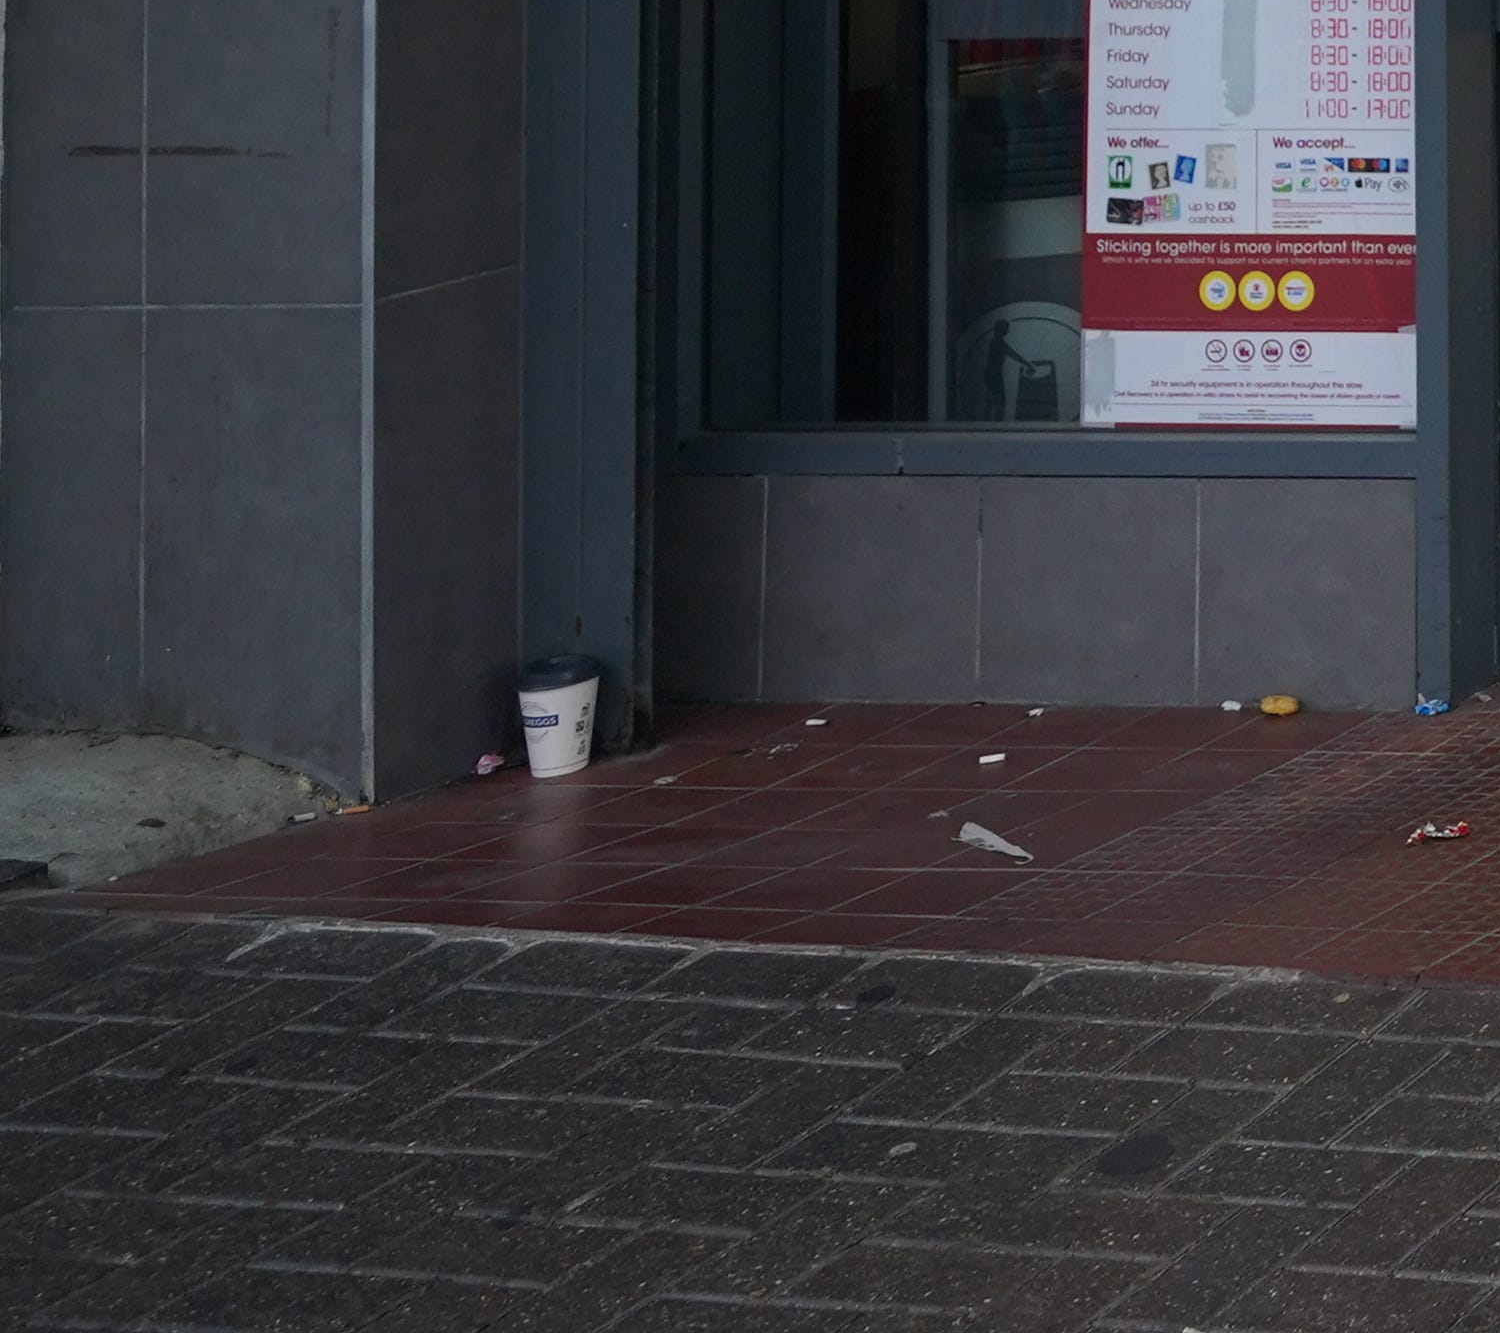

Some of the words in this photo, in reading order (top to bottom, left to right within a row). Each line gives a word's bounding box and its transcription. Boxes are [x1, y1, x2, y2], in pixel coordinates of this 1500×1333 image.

[1107, 22, 1171, 38] Thursday
[1106, 49, 1149, 65] Friday
[1106, 76, 1170, 91] Saturday
[1106, 102, 1160, 118] Sunday
[1107, 136, 1127, 148] We
[1272, 136, 1292, 149] We
[1364, 177, 1382, 192] Pay
[1188, 202, 1202, 212] up
[1205, 201, 1215, 210] to
[1218, 201, 1236, 211] £50
[1188, 214, 1235, 224] cashback
[1096, 238, 1151, 256] Sticking
[1155, 239, 1216, 256] together
[1220, 240, 1231, 253] is
[1235, 242, 1272, 254] more
[1276, 240, 1347, 256] important
[1352, 240, 1384, 254] than
